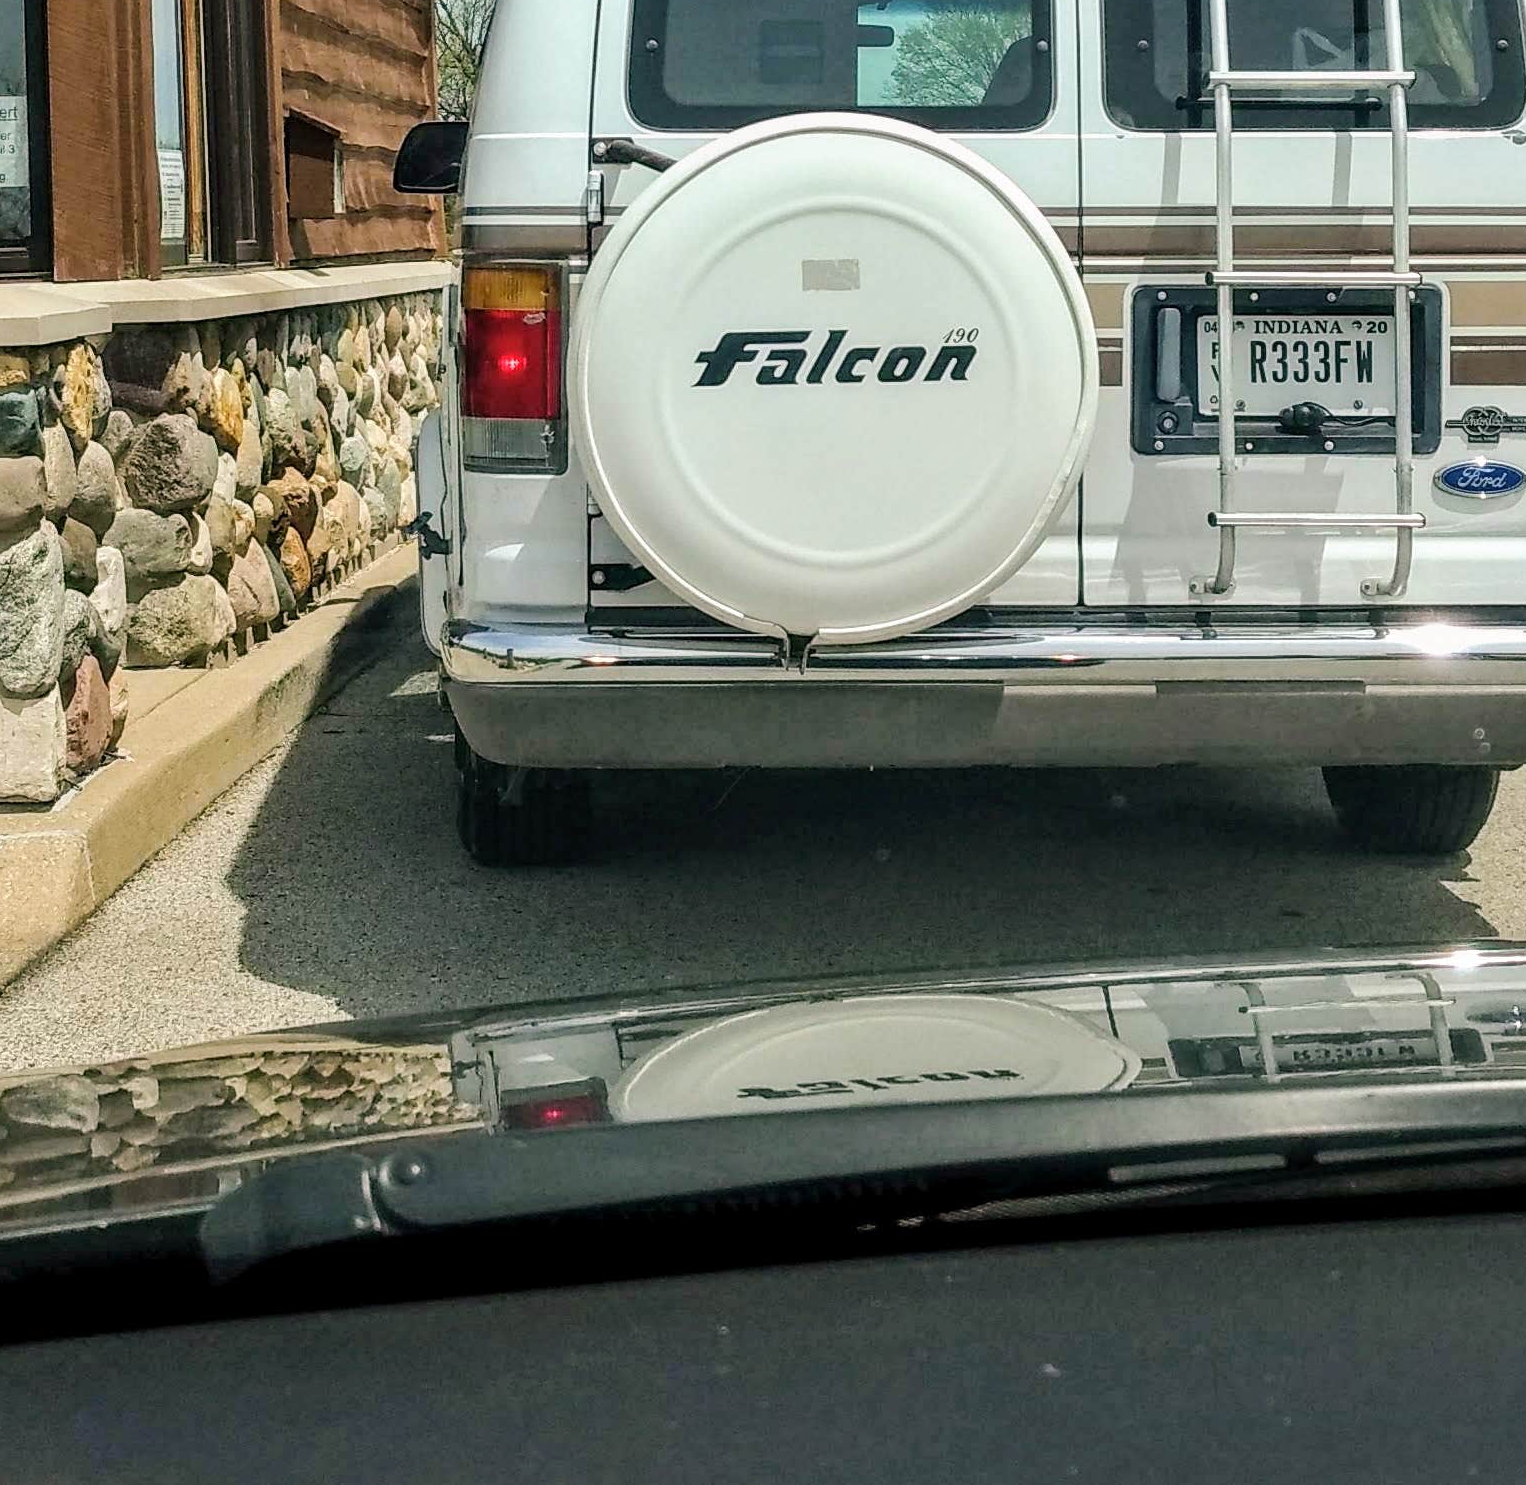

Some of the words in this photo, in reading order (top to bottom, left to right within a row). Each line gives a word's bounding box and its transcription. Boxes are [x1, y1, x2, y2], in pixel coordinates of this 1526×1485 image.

[8, 144, 16, 155] 3
[942, 328, 980, 344] 190
[1254, 320, 1344, 334] INDIANA
[1366, 321, 1388, 334] 20
[691, 330, 978, 387] Falcon
[1250, 340, 1373, 384] R333FW
[1457, 466, 1508, 488] Ford
